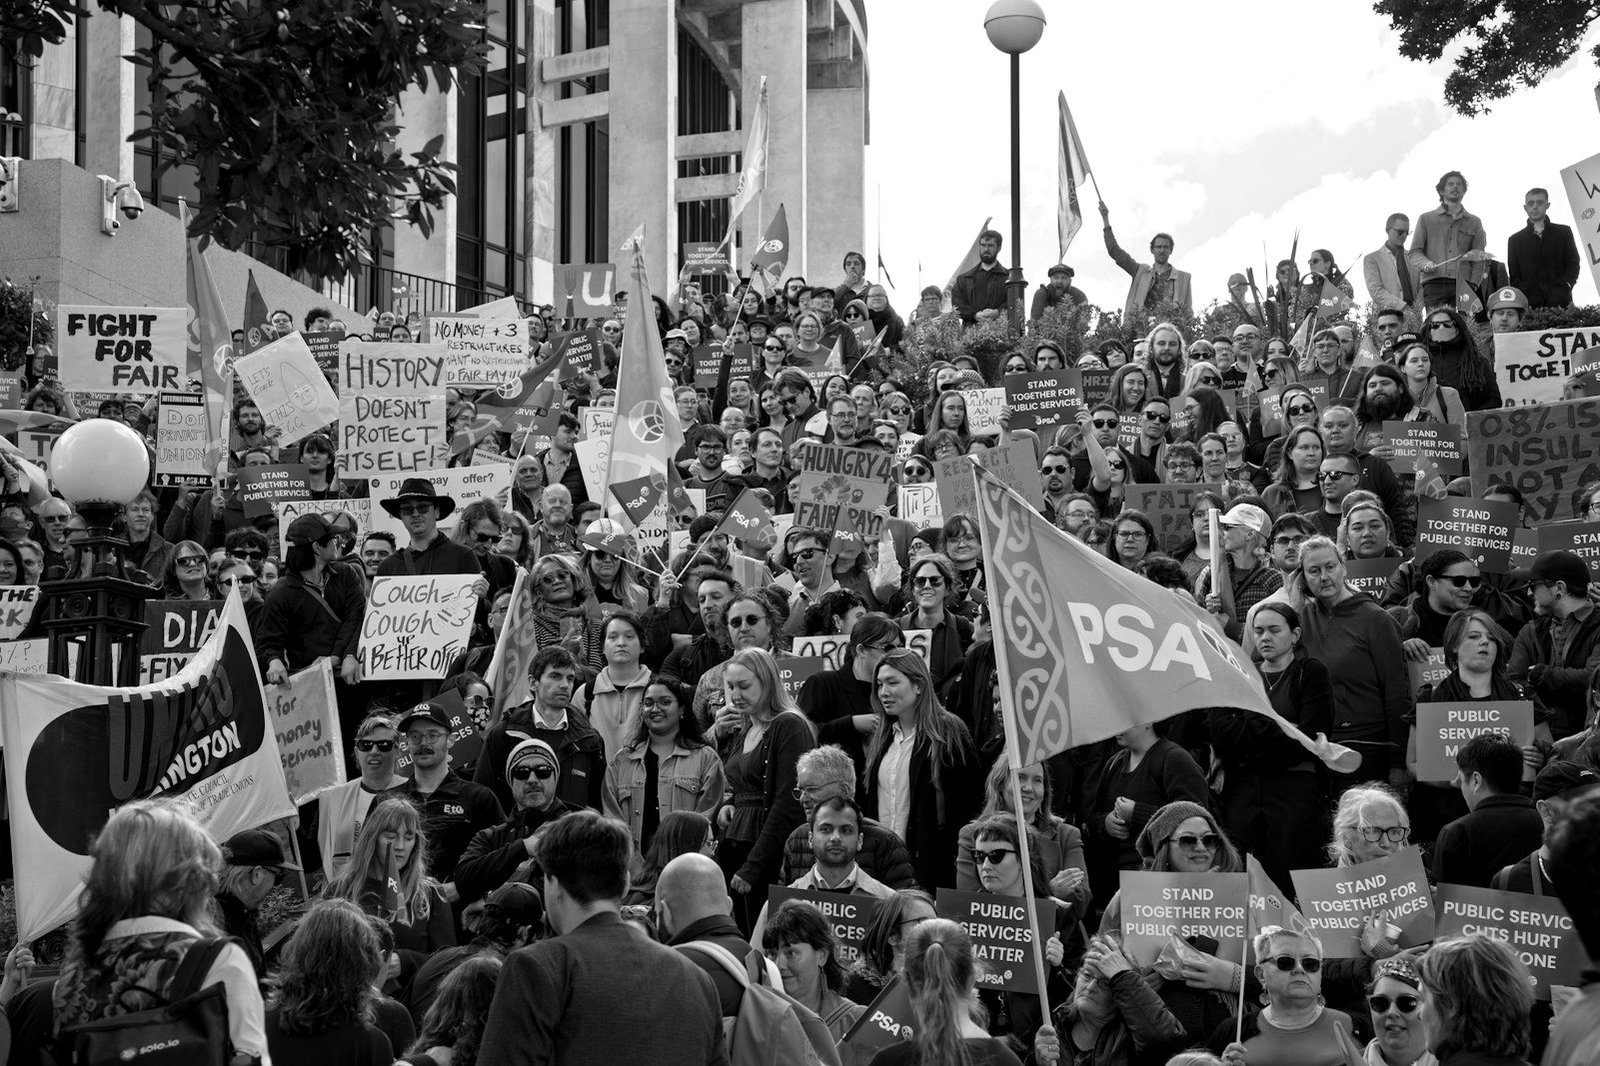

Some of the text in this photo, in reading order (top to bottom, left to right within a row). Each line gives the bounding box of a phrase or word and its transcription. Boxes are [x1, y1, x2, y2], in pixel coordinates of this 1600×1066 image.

[67, 314, 157, 337] FIGHT
[435, 321, 451, 340] NO
[453, 322, 485, 338] MONEY
[505, 323, 518, 337] 3
[447, 340, 522, 353] RESTRUCTURES
[570, 335, 588, 345] UBLIC
[95, 340, 153, 362] FOR
[568, 353, 593, 365] MATTER
[112, 365, 179, 389] FAIR
[345, 353, 444, 389] HISTORY
[459, 368, 481, 381] FAIR
[1027, 379, 1058, 389] STAND
[1012, 387, 1076, 401] TOGETHER FOR
[266, 402, 296, 425] THIS
[355, 396, 432, 422] DOESN'T
[973, 407, 989, 415] AN
[1008, 398, 1082, 412] PUBLIC SERVICES
[1568, 401, 1599, 428] IS
[344, 425, 438, 449] PROTECT
[1408, 429, 1438, 438] STAND
[1391, 438, 1455, 449] TOGETHER FOR
[343, 445, 436, 472] ITSELF!
[803, 445, 874, 479] HUNGRY
[261, 471, 289, 480] STAND
[462, 473, 494, 484] offer?
[246, 480, 305, 491] TOGETHER FOR
[243, 489, 310, 501] PUBLIC SERVICES
[461, 490, 482, 499] can't
[626, 495, 648, 510] PSA
[283, 500, 371, 517] APPRECIATIO
[1452, 508, 1491, 521] STAND
[731, 510, 750, 528] PSA
[1427, 519, 1509, 536] TOGETHER FOR
[835, 529, 854, 541] PSA
[1419, 533, 1511, 551] PUBLIC SERVICES
[1067, 601, 1213, 681] PSA
[371, 643, 428, 675] BETTER
[276, 695, 297, 717] for
[1448, 710, 1500, 722] PUBLIC
[207, 790, 230, 806] TRADE
[1335, 874, 1387, 895] STAND
[1162, 887, 1214, 901] STAND
[1311, 881, 1417, 913] TOGETHER FOR
[970, 902, 1025, 921] PUBLIC
[1133, 905, 1245, 920] TOGETHER FOR
[1309, 896, 1429, 930] PUBLIC SRVICES
[1443, 900, 1504, 921] PUBLIC
[961, 921, 1032, 943] SERVICES
[1126, 922, 1244, 938] PUBLIC SERVICE
[1513, 932, 1562, 949] HURT
[985, 974, 1005, 985] PSA
[870, 1010, 902, 1036] PSA
[139, 1038, 180, 1055] solo.io
